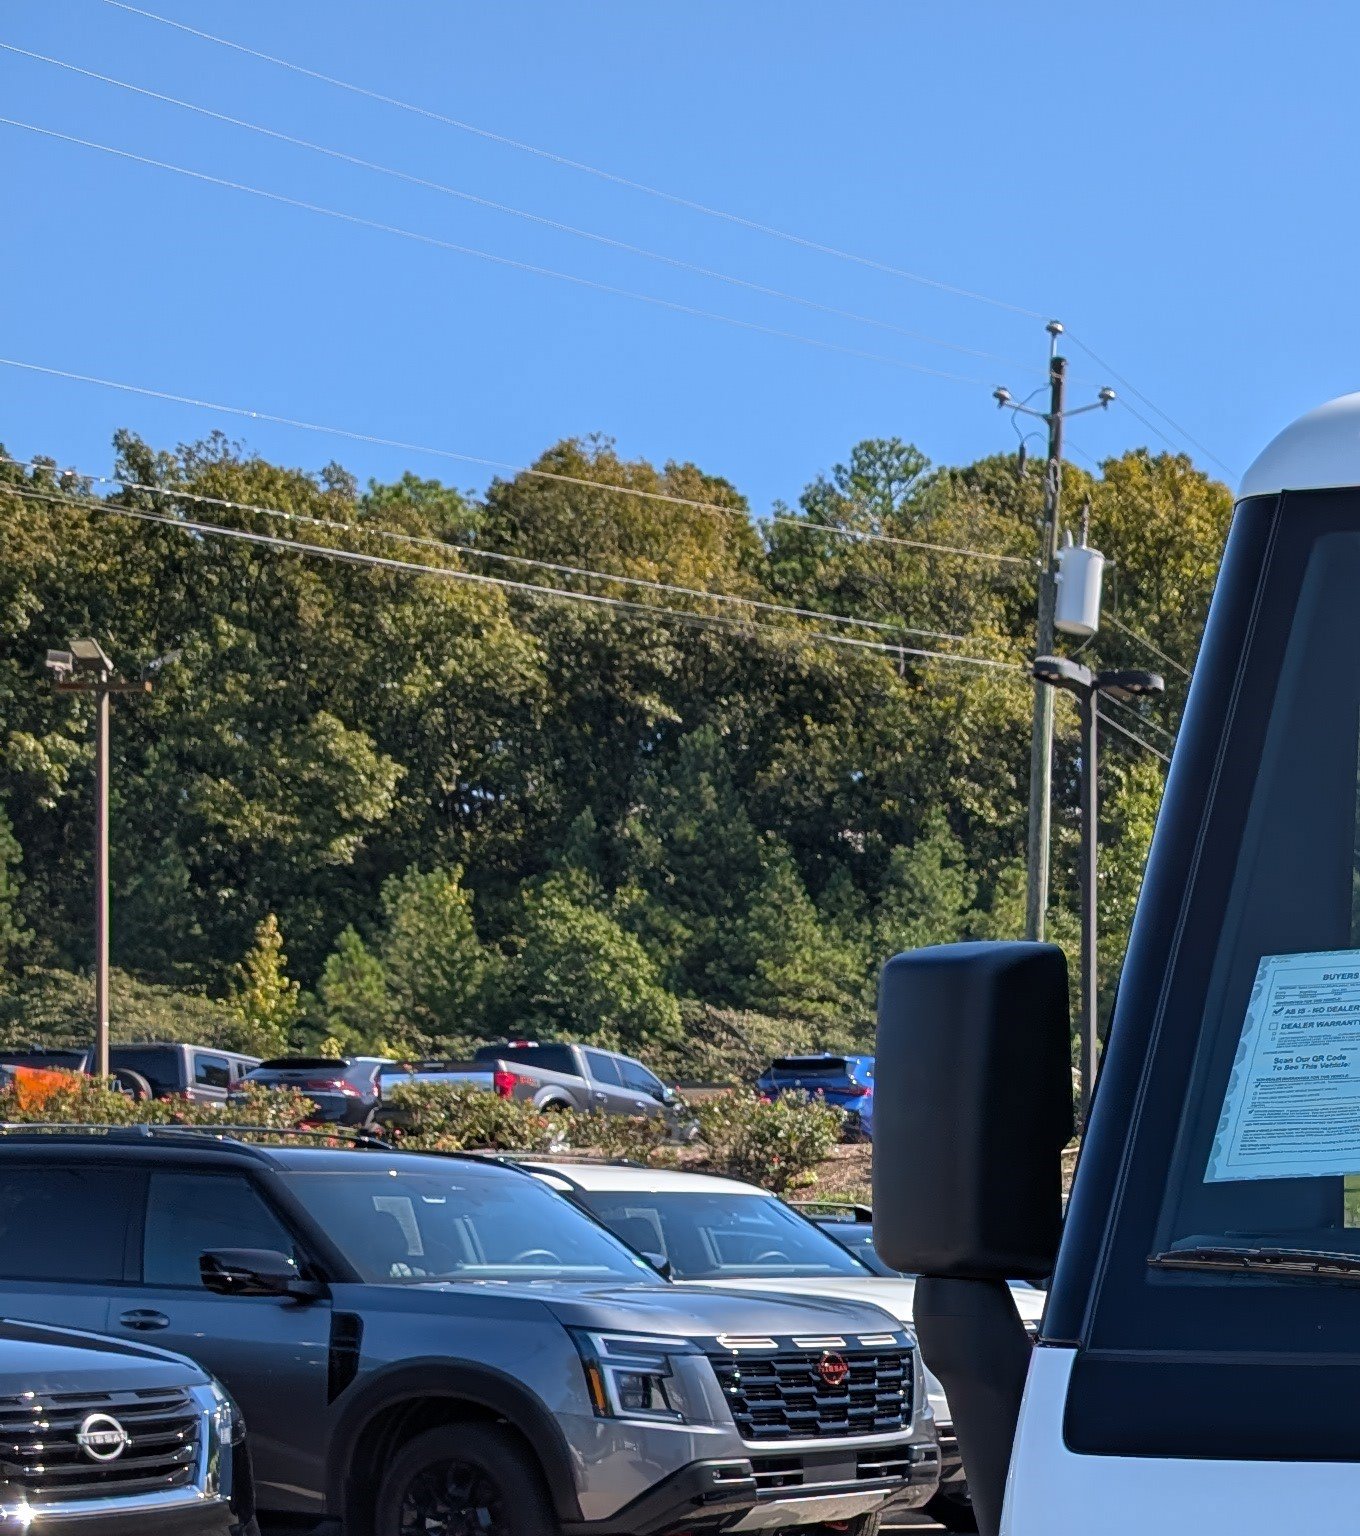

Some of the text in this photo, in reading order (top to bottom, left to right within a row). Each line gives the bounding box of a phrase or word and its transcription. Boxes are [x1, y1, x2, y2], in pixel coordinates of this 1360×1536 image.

[1322, 972, 1359, 981] BUYERS
[1326, 1004, 1360, 1012] DEALER
[1280, 1021, 1315, 1030] DEALER
[1312, 1054, 1325, 1062] QR
[1326, 1053, 1347, 1061] Code
